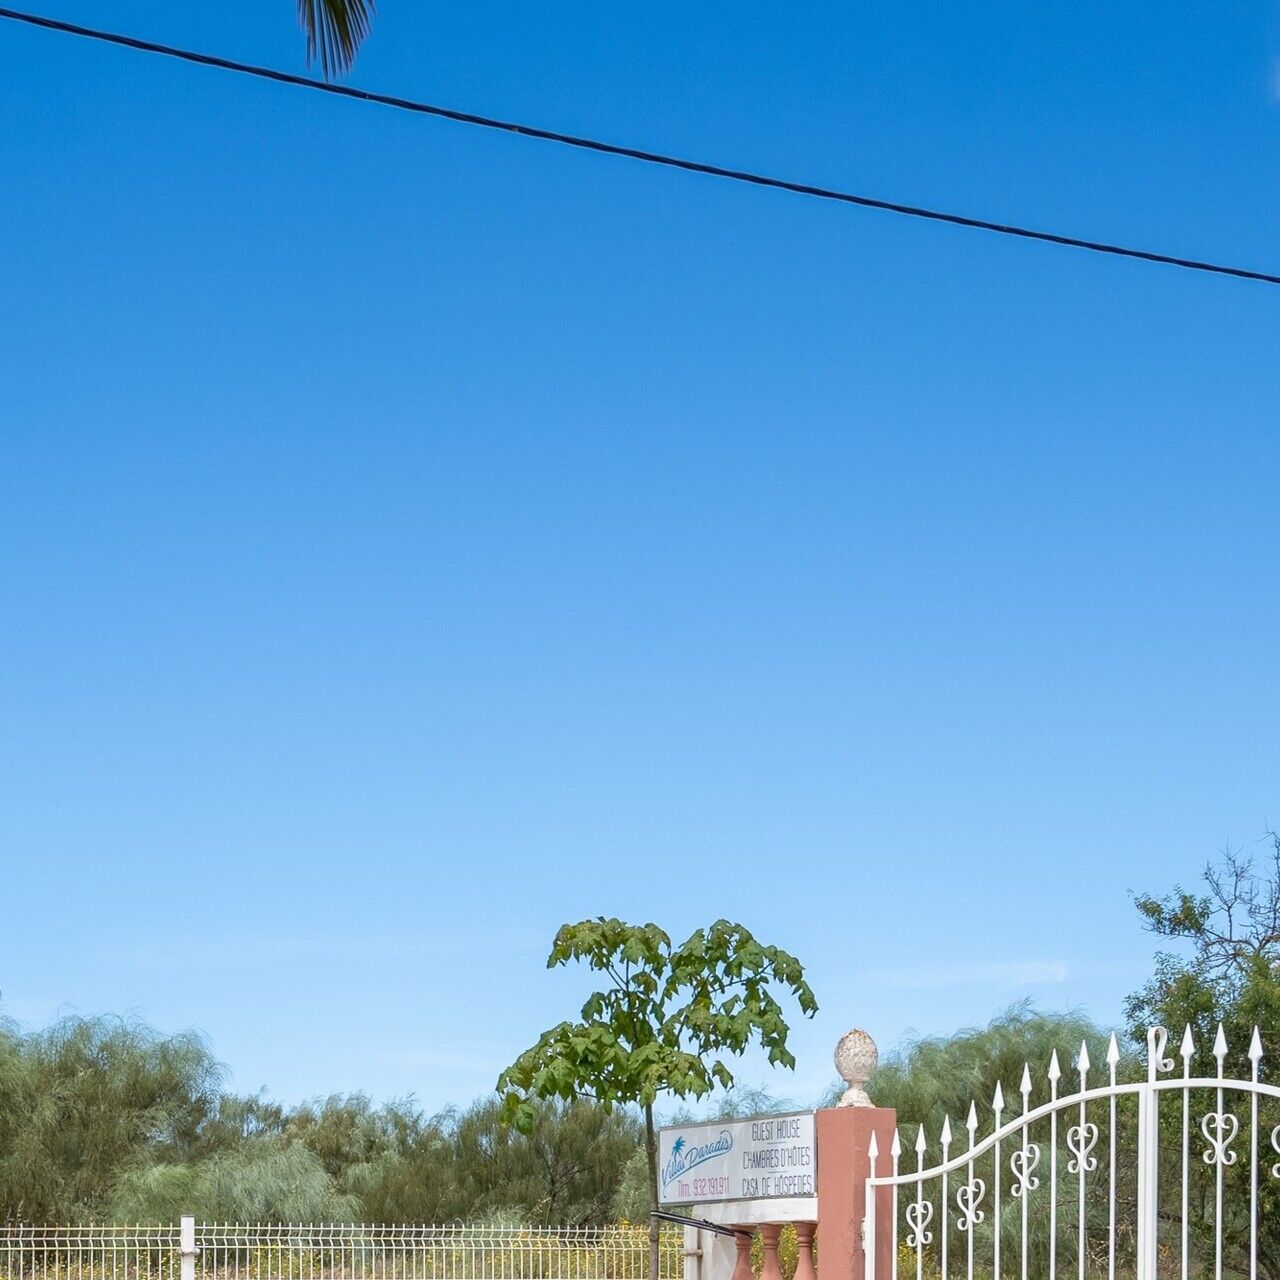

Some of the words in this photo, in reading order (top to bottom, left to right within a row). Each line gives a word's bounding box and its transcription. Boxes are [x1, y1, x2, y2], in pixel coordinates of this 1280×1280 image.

[752, 1121, 773, 1141] GUEST
[776, 1118, 800, 1139] HOUSE
[684, 1132, 732, 1168] Paradis
[742, 1149, 779, 1170] CHAMBRES
[780, 1145, 811, 1167] D'HÔTES
[742, 1177, 759, 1197] CASA
[761, 1177, 771, 1196] DE
